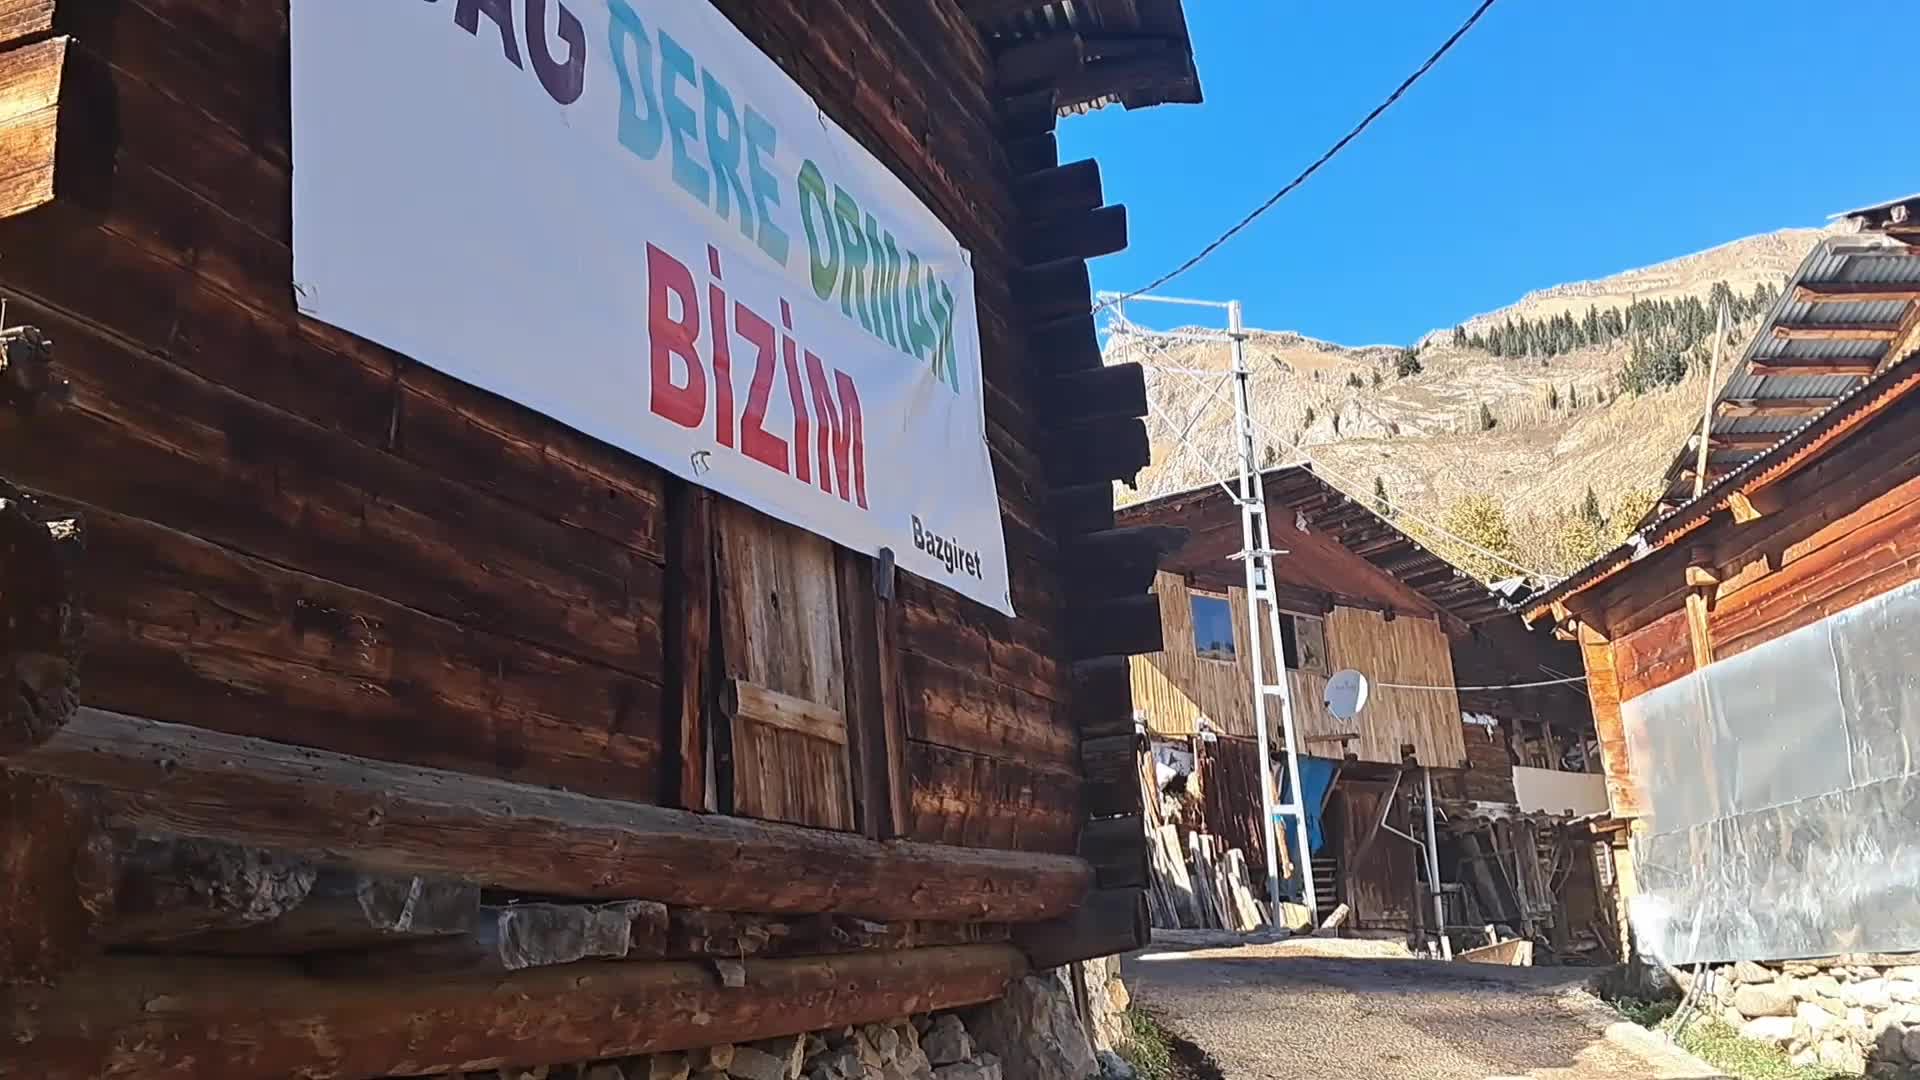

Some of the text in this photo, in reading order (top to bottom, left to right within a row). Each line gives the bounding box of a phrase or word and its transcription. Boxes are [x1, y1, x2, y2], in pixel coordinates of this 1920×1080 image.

[607, 0, 790, 268] DERE
[646, 240, 869, 510] BİZİM
[911, 513, 983, 581] Bazgiret
